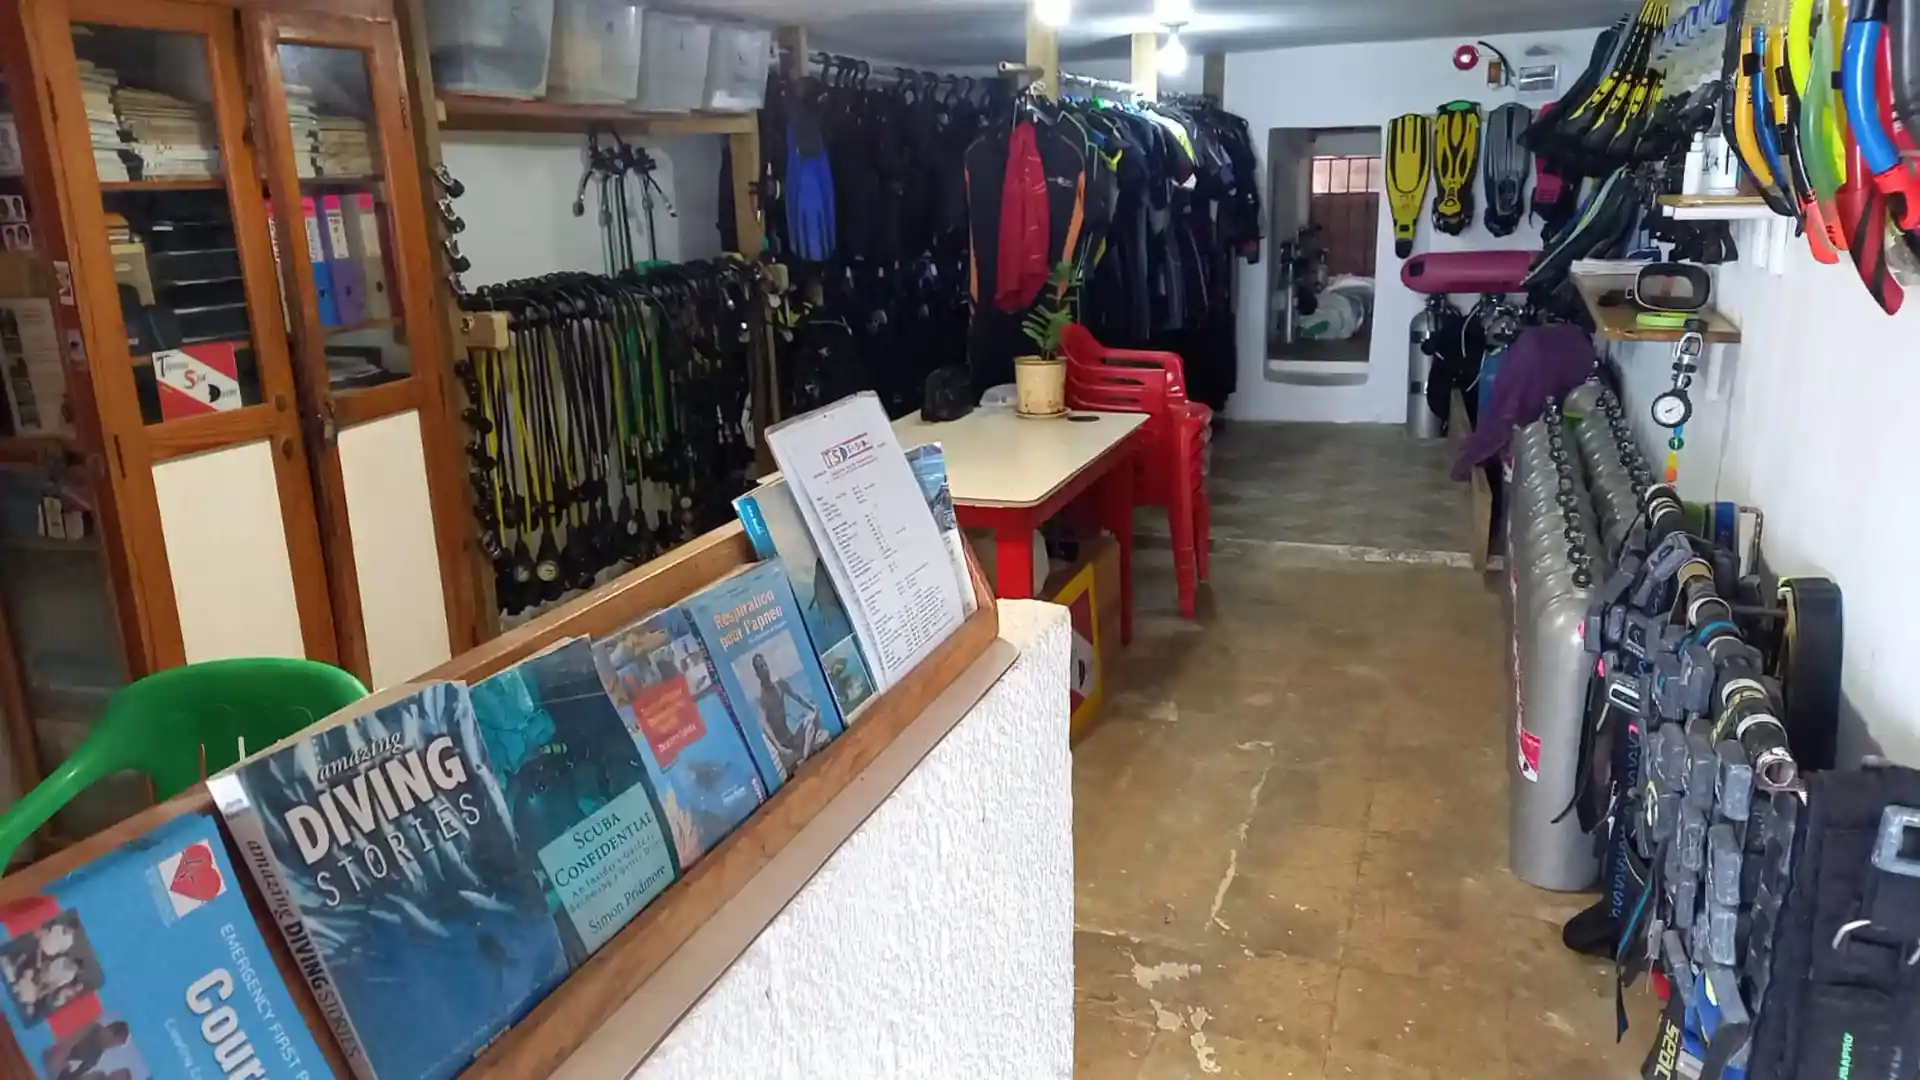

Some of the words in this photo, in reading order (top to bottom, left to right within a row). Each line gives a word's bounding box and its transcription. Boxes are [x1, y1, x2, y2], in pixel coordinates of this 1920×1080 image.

[718, 628, 743, 652] pour
[318, 730, 404, 784] amazing
[284, 736, 468, 866] DIVING
[572, 813, 621, 850] SCUBA
[316, 793, 481, 907] STORIES
[554, 811, 654, 887] CONFIDENTIAL
[247, 840, 294, 921] amazing
[284, 919, 329, 995] DIVING
[588, 901, 625, 934] Simon
[623, 865, 667, 907] Pridmore
[220, 922, 275, 1022] EMERGENCY
[268, 1022, 302, 1070] FIRST
